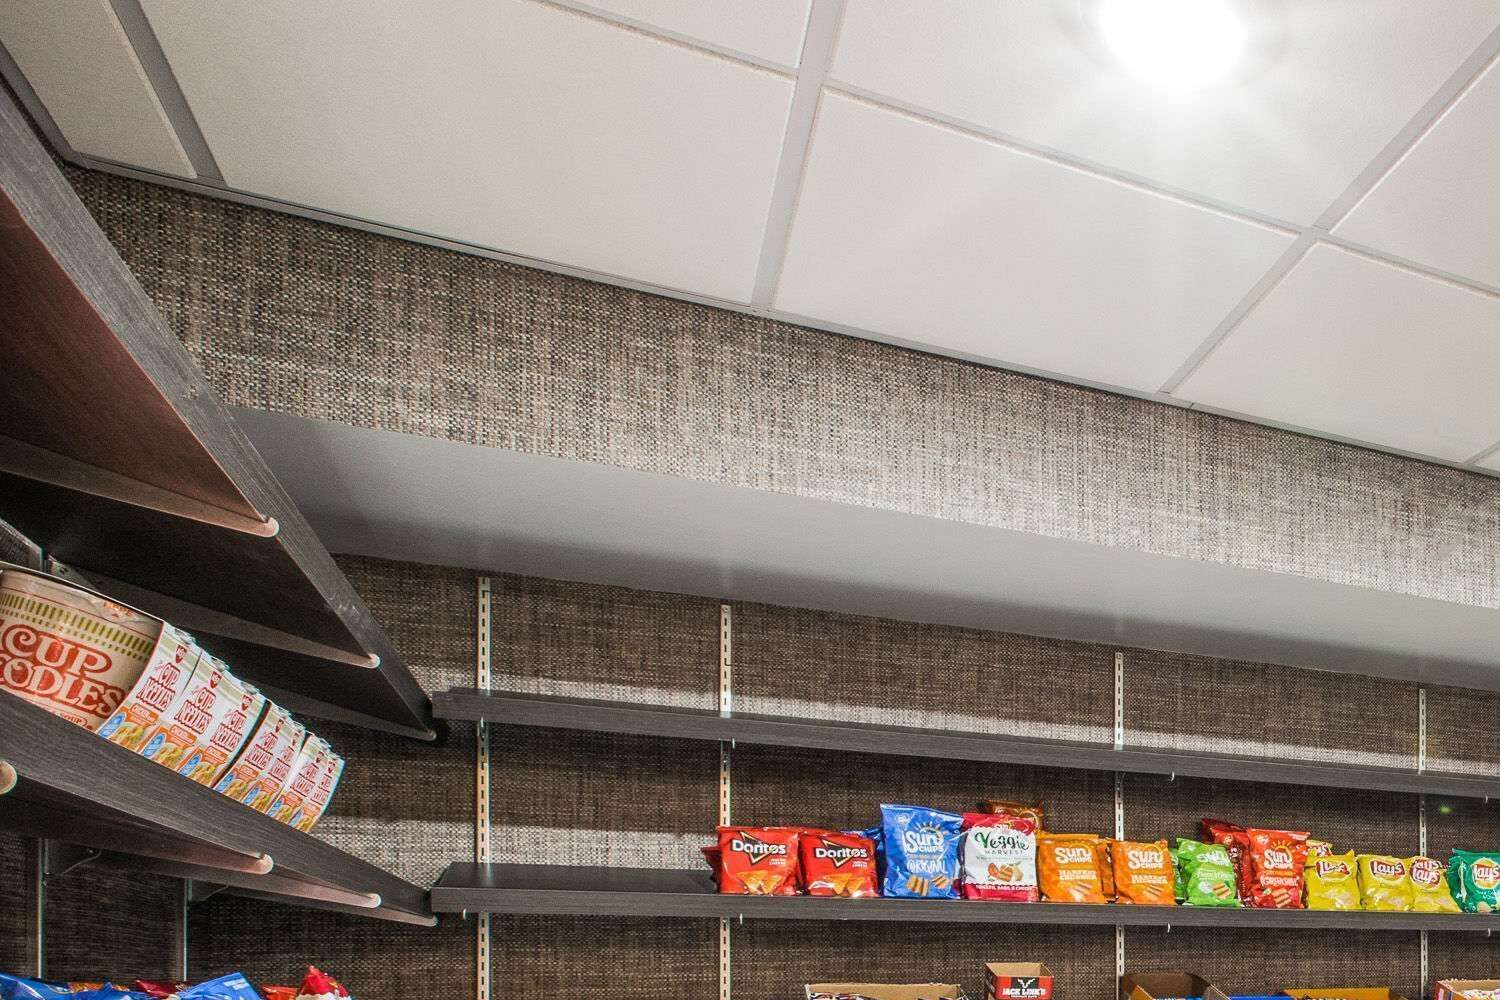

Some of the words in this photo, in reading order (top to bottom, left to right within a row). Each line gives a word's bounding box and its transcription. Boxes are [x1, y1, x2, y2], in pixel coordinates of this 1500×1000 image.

[3, 624, 112, 675] CUP
[0, 655, 125, 718] ODLES
[731, 839, 787, 855] Doritos
[974, 831, 1030, 851] Veggie
[815, 847, 868, 858] Doritos
[1054, 847, 1092, 864] Sun
[1127, 850, 1163, 869] Sun
